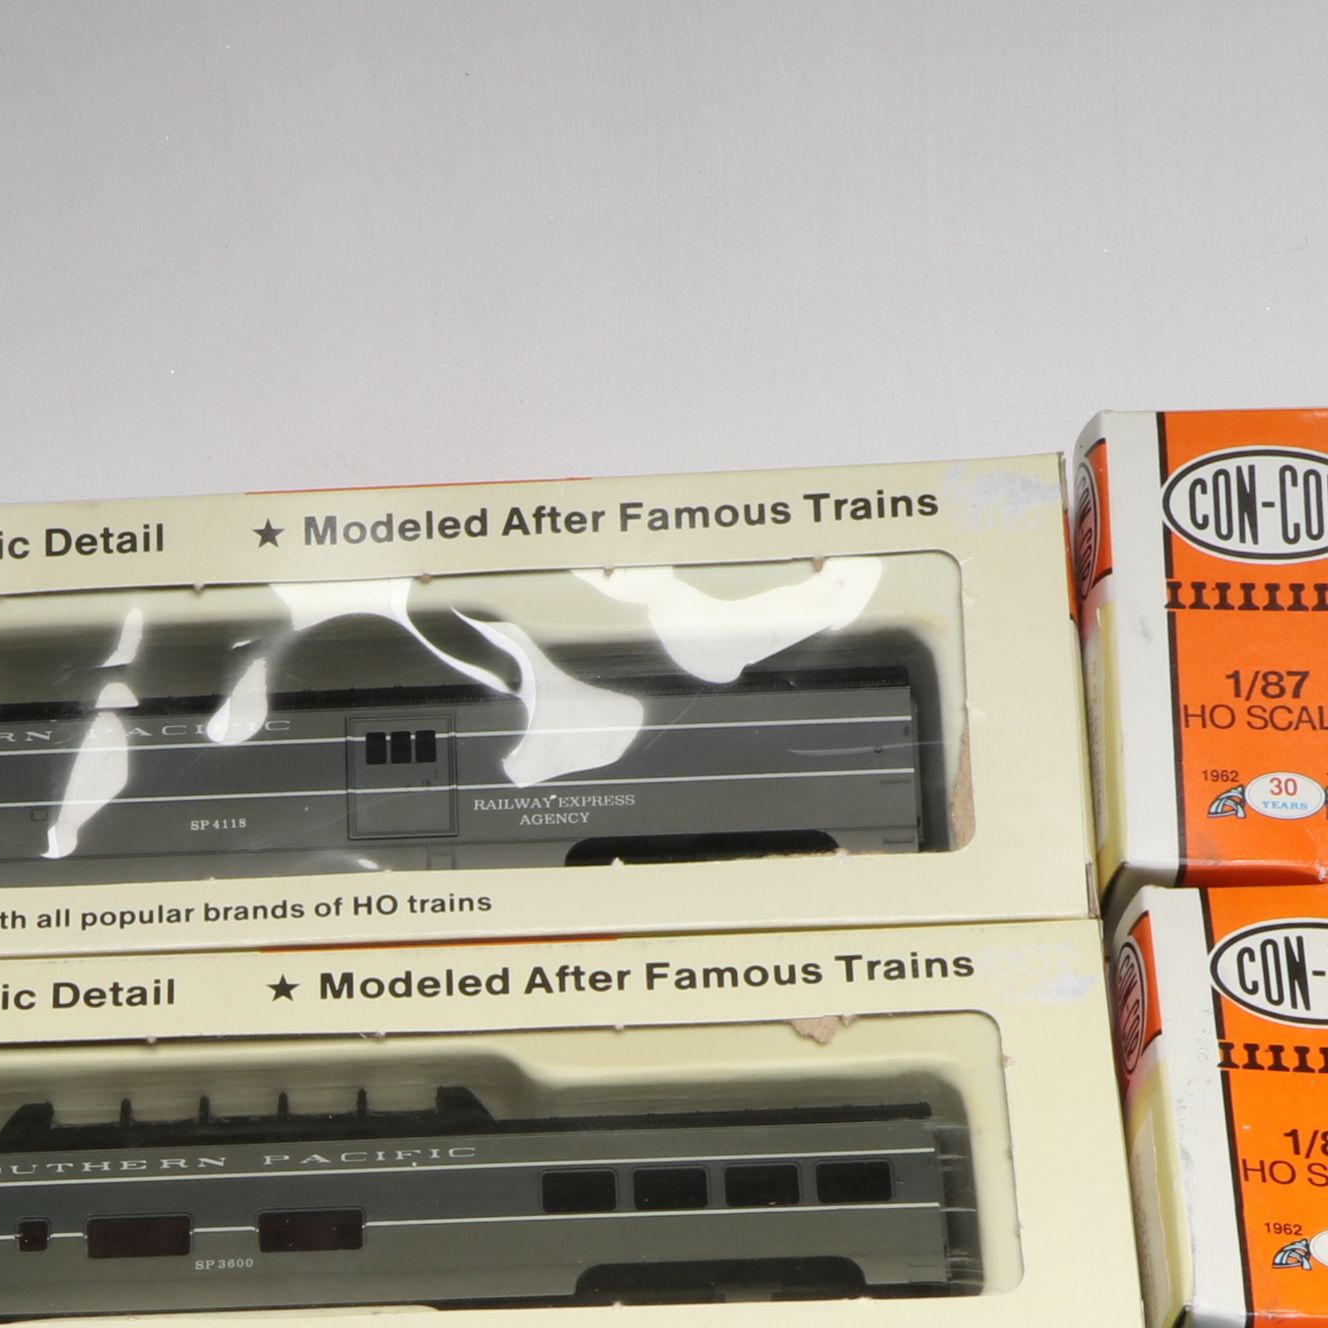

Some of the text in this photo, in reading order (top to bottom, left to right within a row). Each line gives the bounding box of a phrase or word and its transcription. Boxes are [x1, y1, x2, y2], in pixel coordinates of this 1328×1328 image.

[45, 524, 165, 557] Detail
[304, 508, 489, 546] Modeled
[502, 506, 605, 537] After
[620, 497, 790, 533] Famous
[803, 490, 939, 523] Trains
[1225, 671, 1310, 700] 1/87
[1183, 705, 1235, 730] HO
[1202, 770, 1240, 783] 1962
[1269, 778, 1298, 797] 30
[474, 794, 635, 812] RAILWAY EXPRESS
[1262, 801, 1308, 811] YEARS
[190, 818, 247, 830] SP 4118
[520, 812, 590, 826] AGENCY
[36, 907, 71, 928] all
[80, 904, 194, 930] popular
[203, 899, 305, 922] brands
[315, 897, 344, 917] of
[352, 895, 399, 916] HO
[408, 893, 492, 914] trains
[52, 979, 175, 1010] Detail
[320, 967, 510, 1000] Modeled
[524, 965, 631, 995] After
[646, 960, 823, 992] Famous
[835, 951, 975, 983] Trains
[262, 1146, 478, 1165] PACIFIC
[1242, 1160, 1296, 1184] HO
[1264, 1222, 1303, 1235] 1962
[194, 1258, 254, 1270] SP 3600
